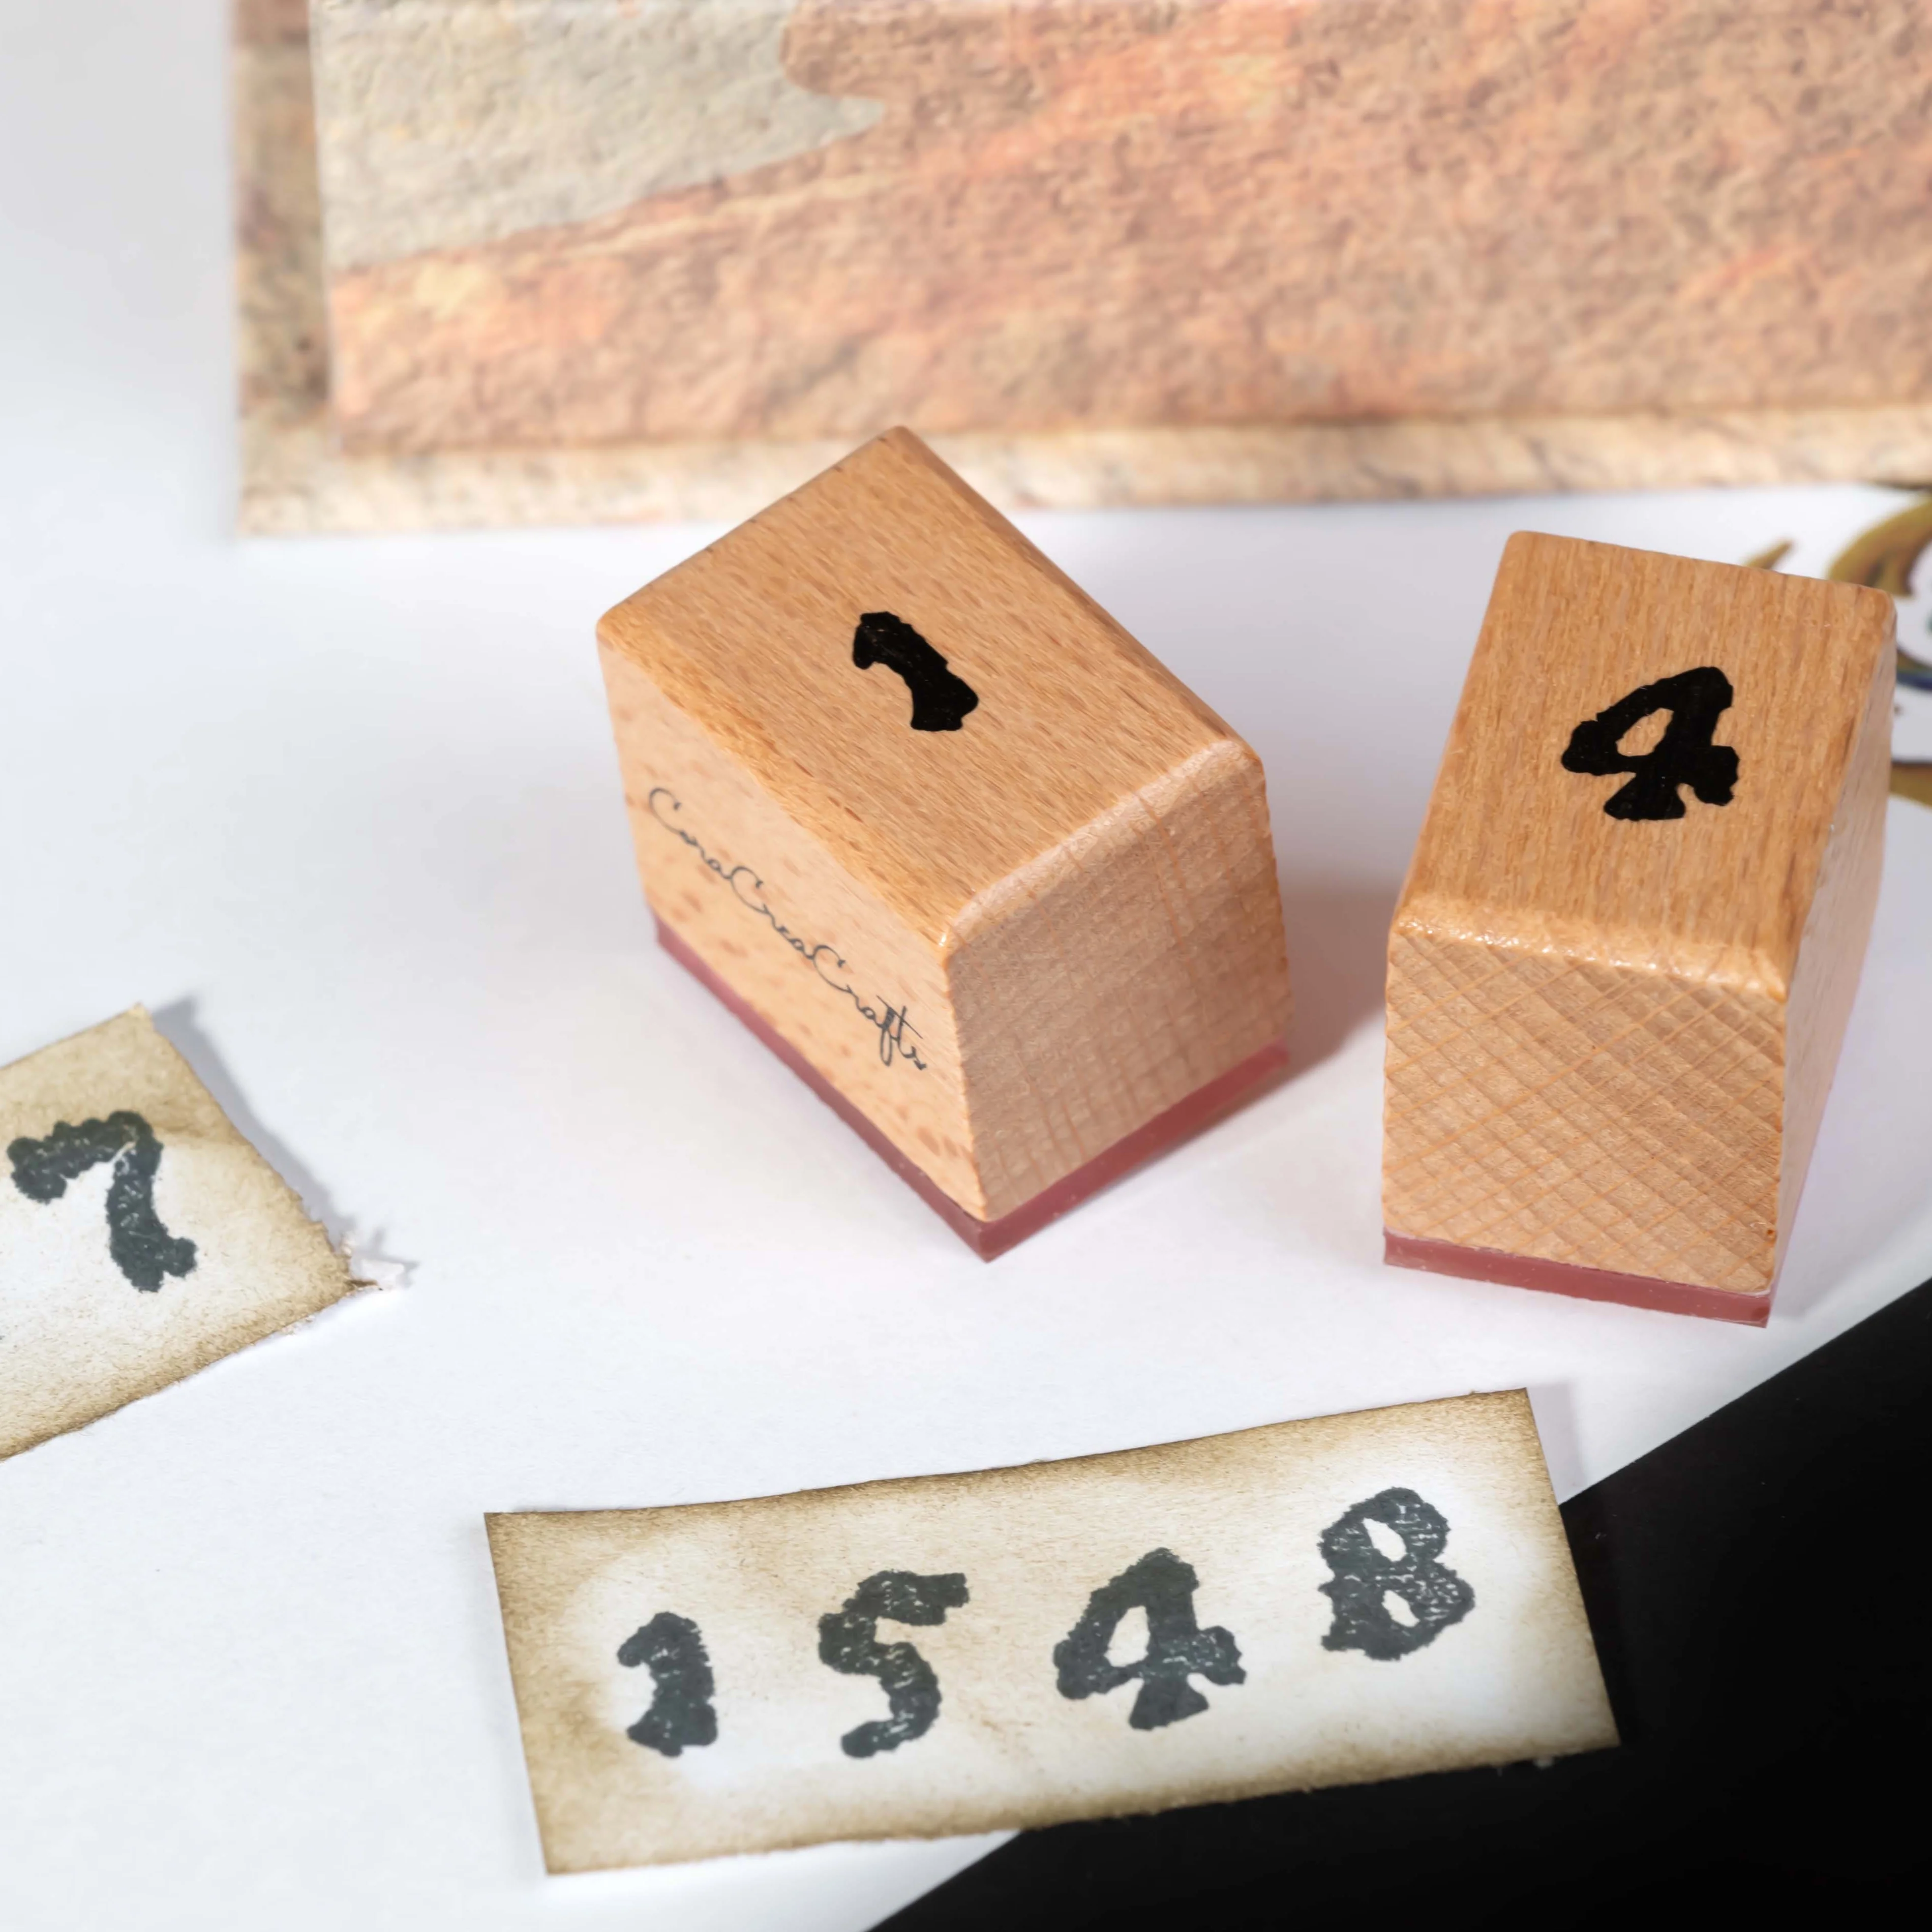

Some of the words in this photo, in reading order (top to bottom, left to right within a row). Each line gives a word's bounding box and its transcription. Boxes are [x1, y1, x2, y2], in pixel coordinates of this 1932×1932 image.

[852, 606, 979, 732] 1
[1560, 667, 1740, 822] 4
[7, 1110, 198, 1293] 7
